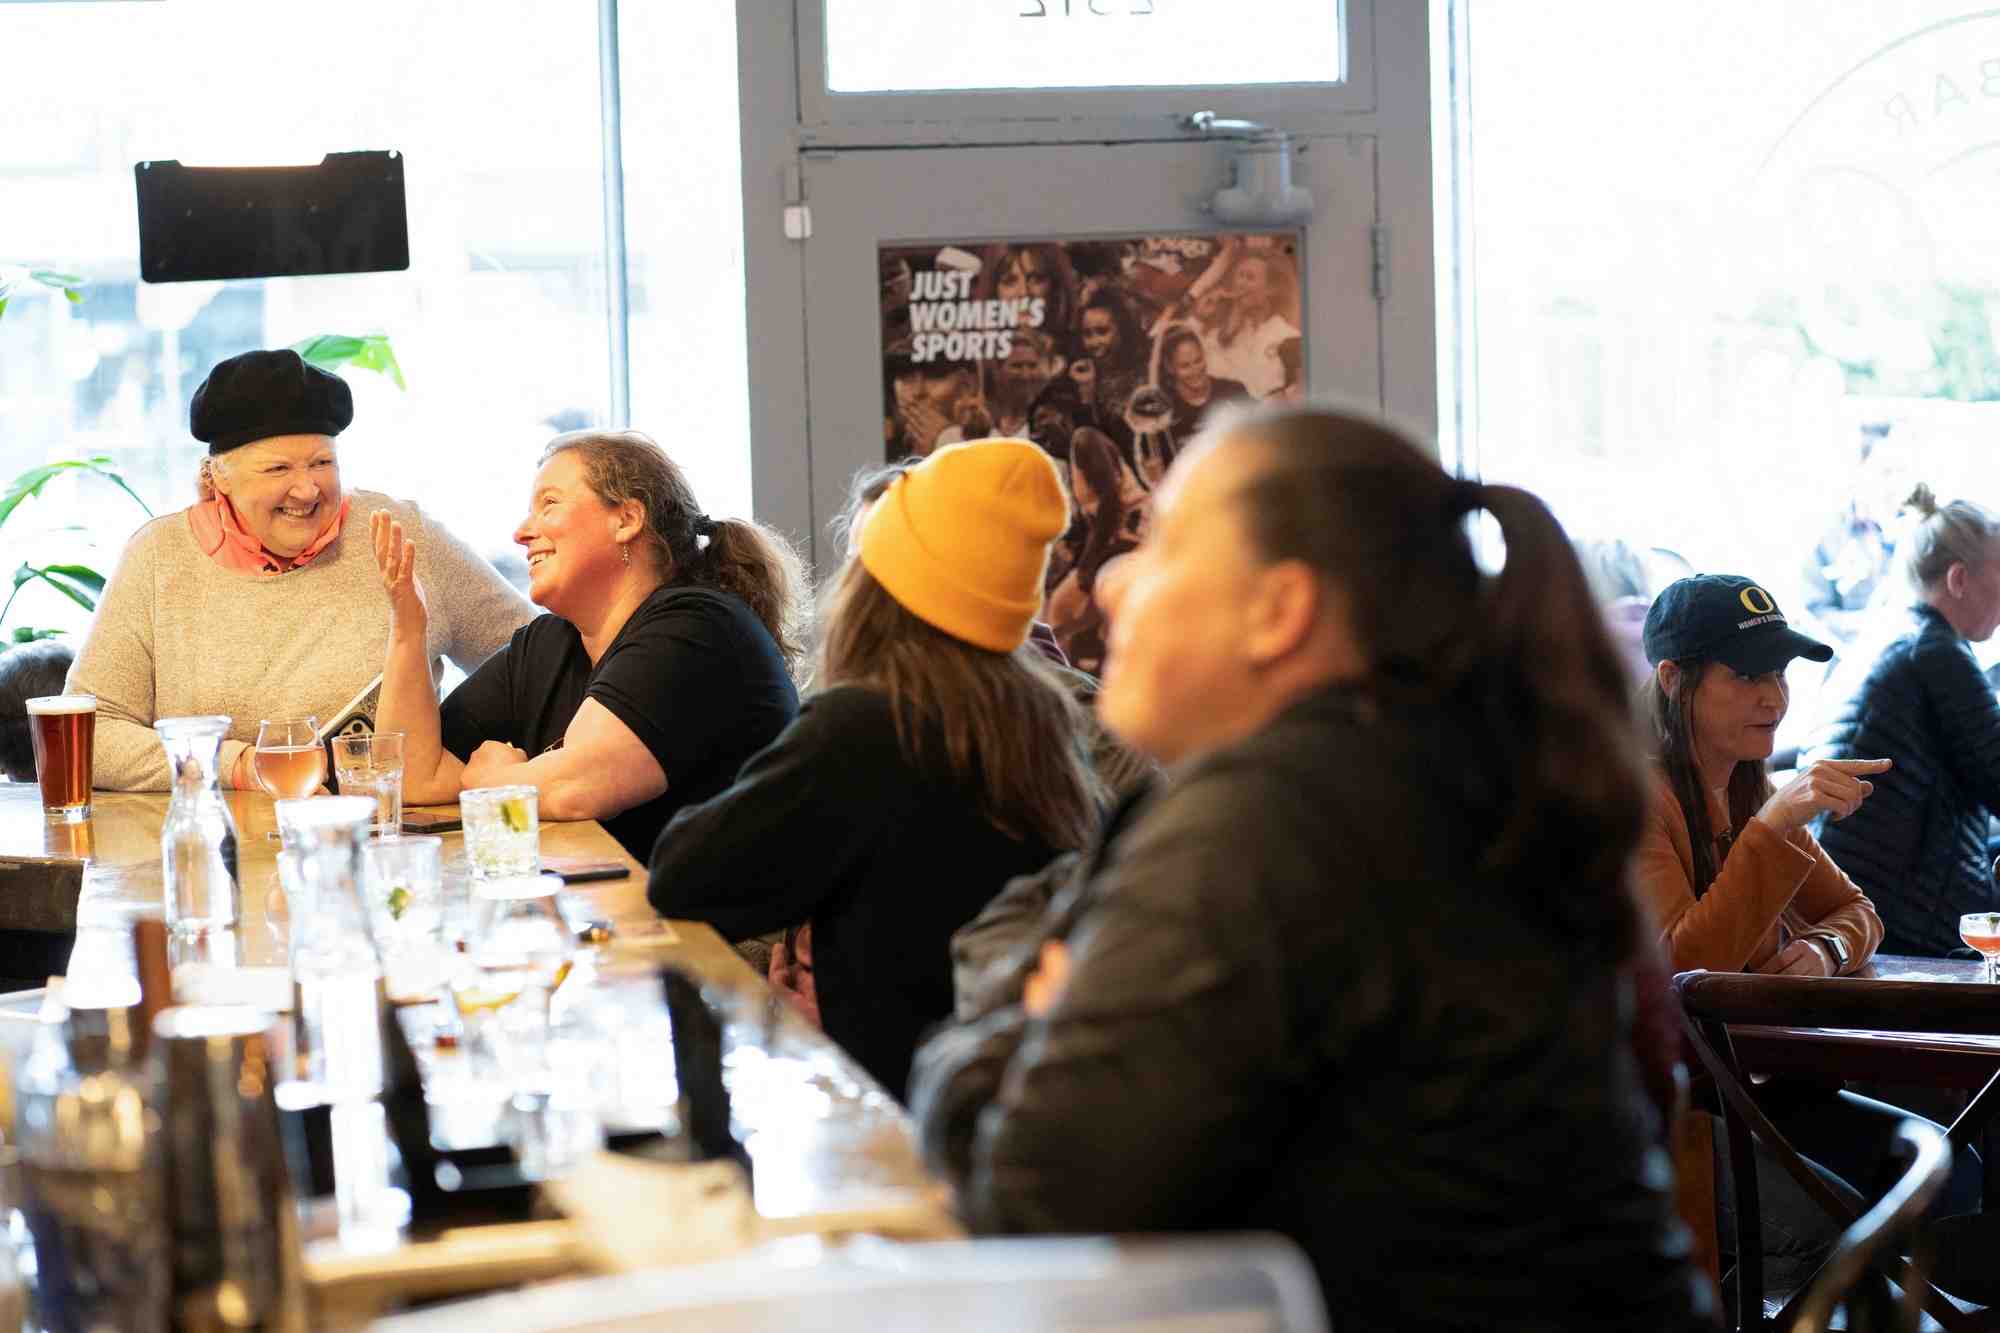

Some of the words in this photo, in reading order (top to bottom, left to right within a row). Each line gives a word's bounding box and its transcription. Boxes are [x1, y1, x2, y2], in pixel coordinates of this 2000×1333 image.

[909, 270, 973, 300] JUST
[909, 296, 1045, 332] WOMEN'S
[910, 329, 1014, 363] SPORTS
[1739, 586, 1774, 613] O
